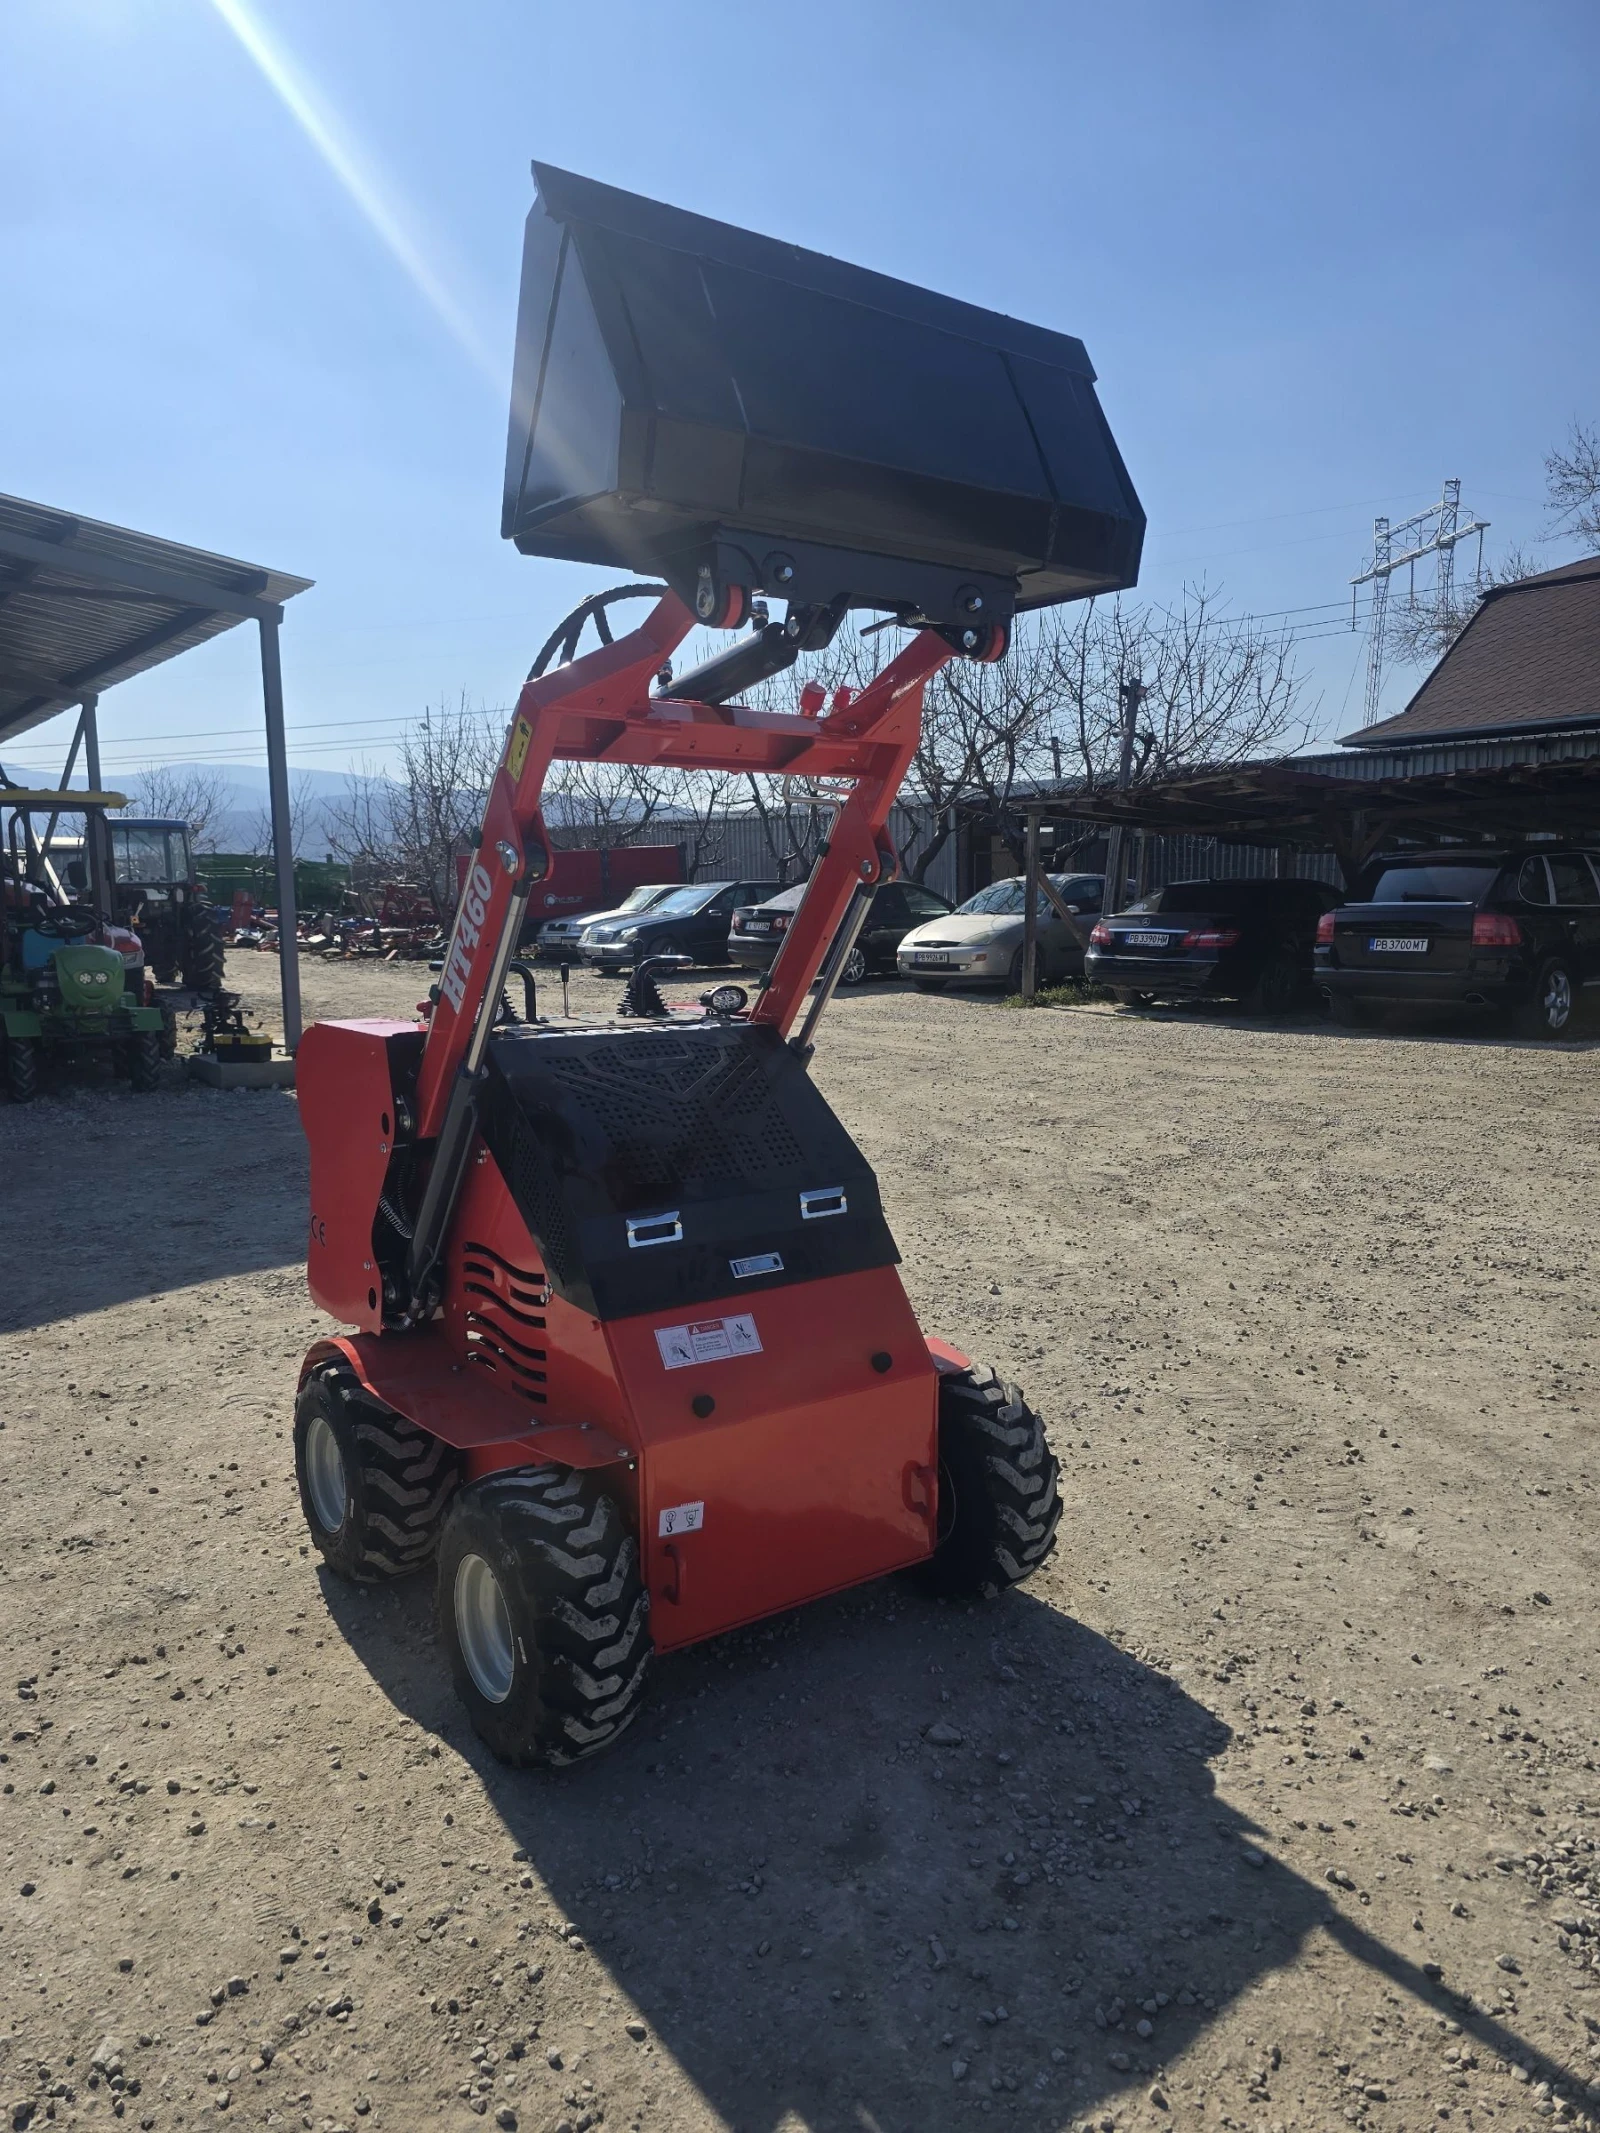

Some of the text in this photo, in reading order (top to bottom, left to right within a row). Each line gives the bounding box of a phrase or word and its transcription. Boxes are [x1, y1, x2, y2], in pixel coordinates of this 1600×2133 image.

[442, 865, 492, 1015] HT460
[1389, 940, 1412, 950] 3700
[311, 1214, 326, 1248] CE
